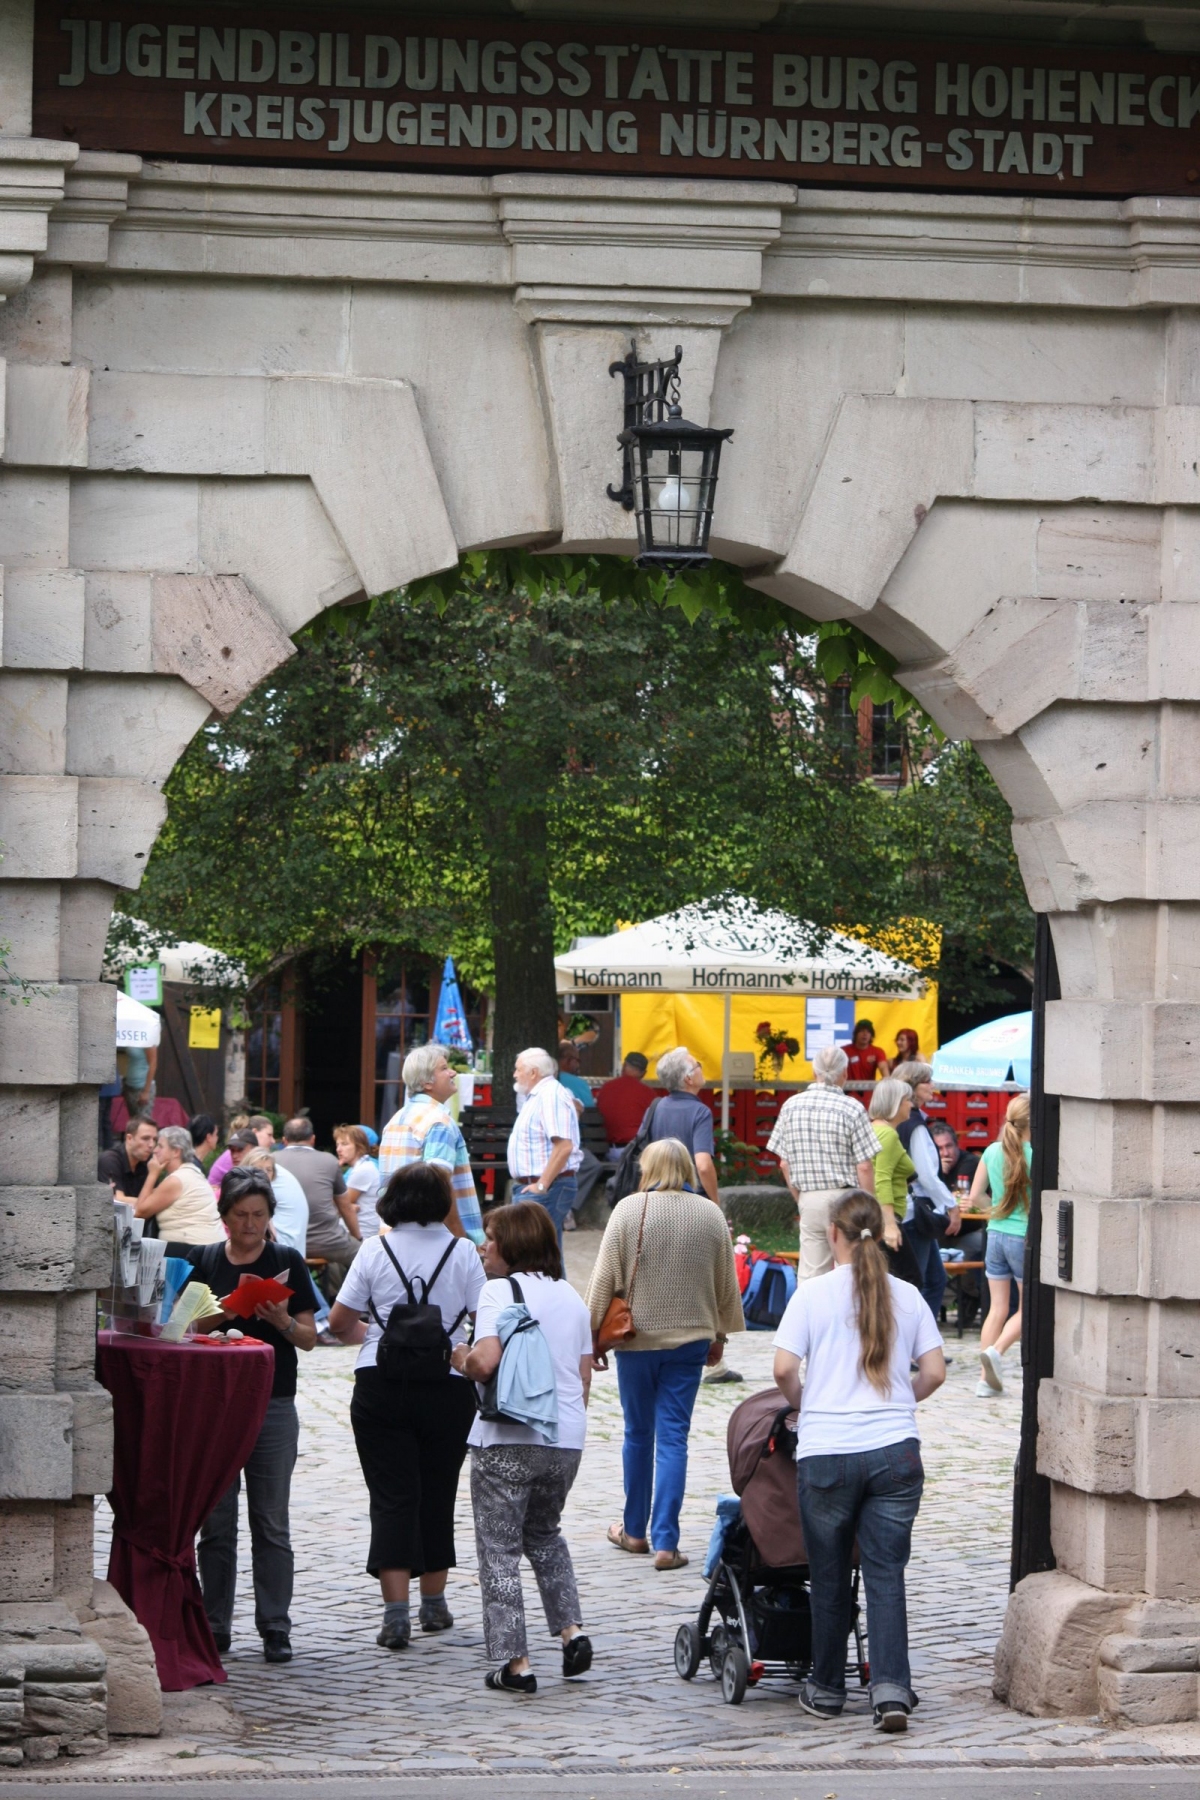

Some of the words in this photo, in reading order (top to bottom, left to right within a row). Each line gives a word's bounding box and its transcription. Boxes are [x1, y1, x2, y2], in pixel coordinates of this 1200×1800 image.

[58, 19, 754, 105] JUGENDBILDUNGSSTÄTTE
[772, 53, 918, 114] BURG
[934, 62, 1200, 128] HOHENECK
[183, 91, 638, 155] KREISJUGENDRING
[660, 109, 1094, 178] NÜRNBERG-STADT
[573, 968, 663, 987] Hofmann
[692, 967, 782, 988] Hofmann
